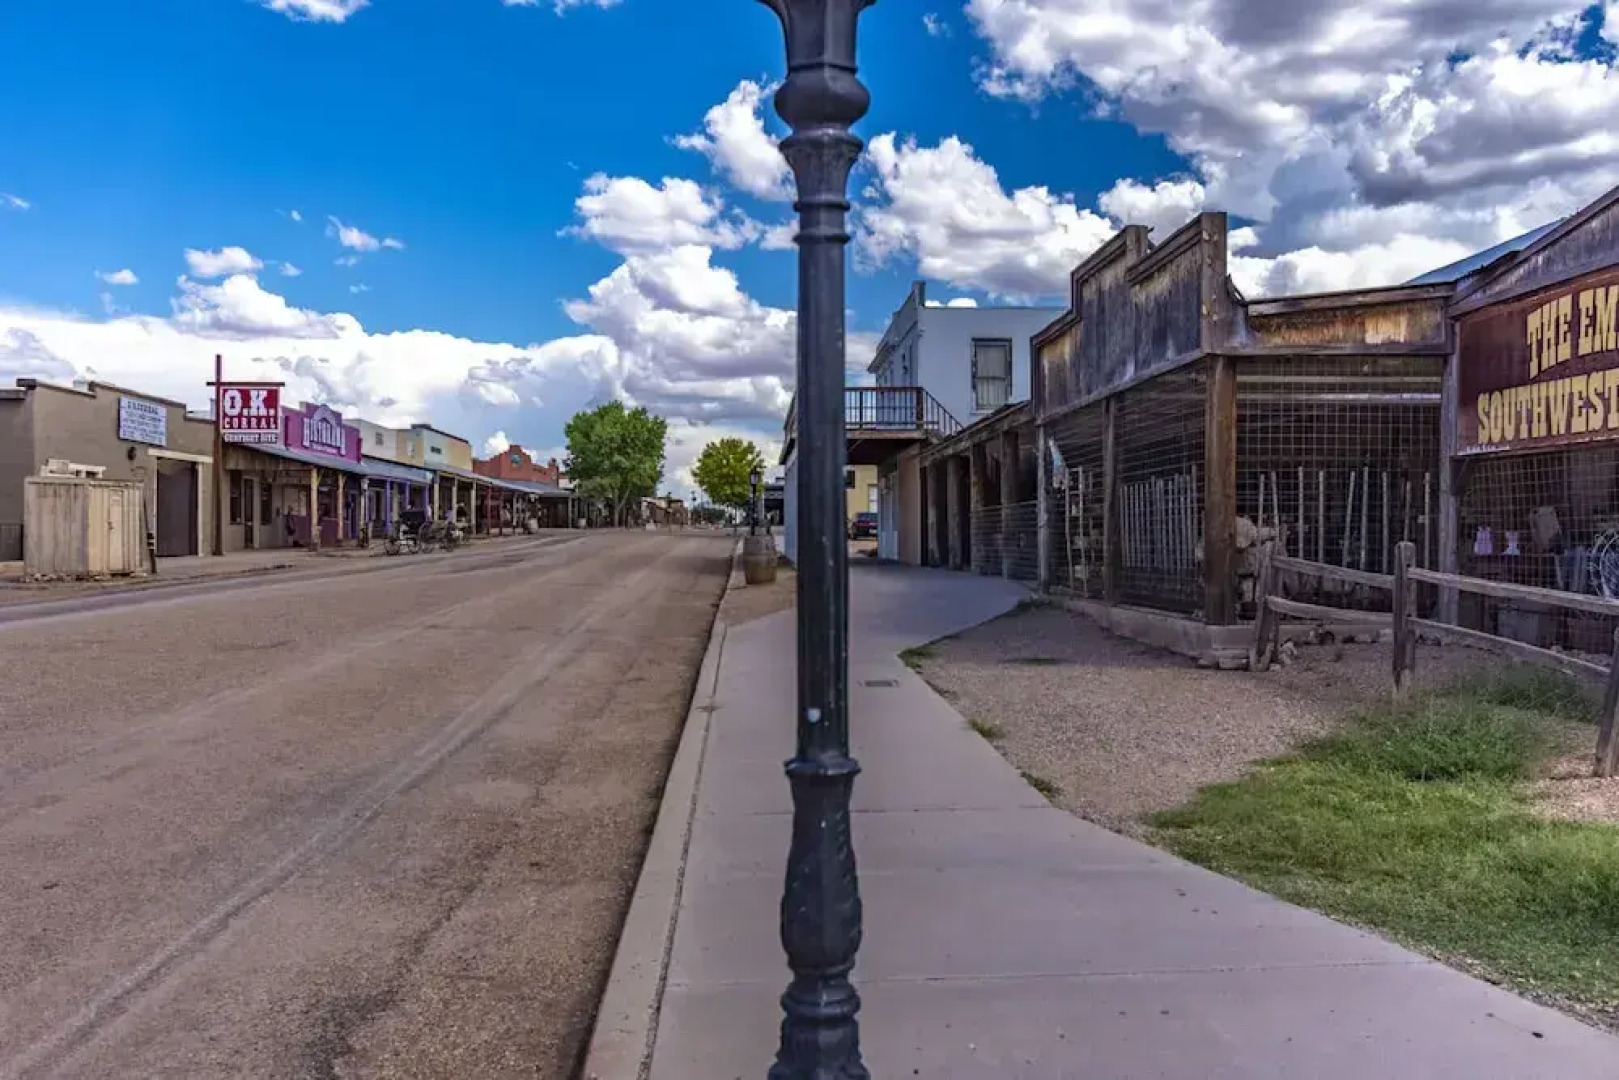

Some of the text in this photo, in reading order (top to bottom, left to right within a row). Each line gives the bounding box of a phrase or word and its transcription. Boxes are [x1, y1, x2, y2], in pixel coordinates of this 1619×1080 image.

[1527, 285, 1619, 379] THE EM
[224, 390, 276, 416] O.K.
[224, 417, 276, 428] CORRAL
[1477, 368, 1619, 445] SOUTHWEST
